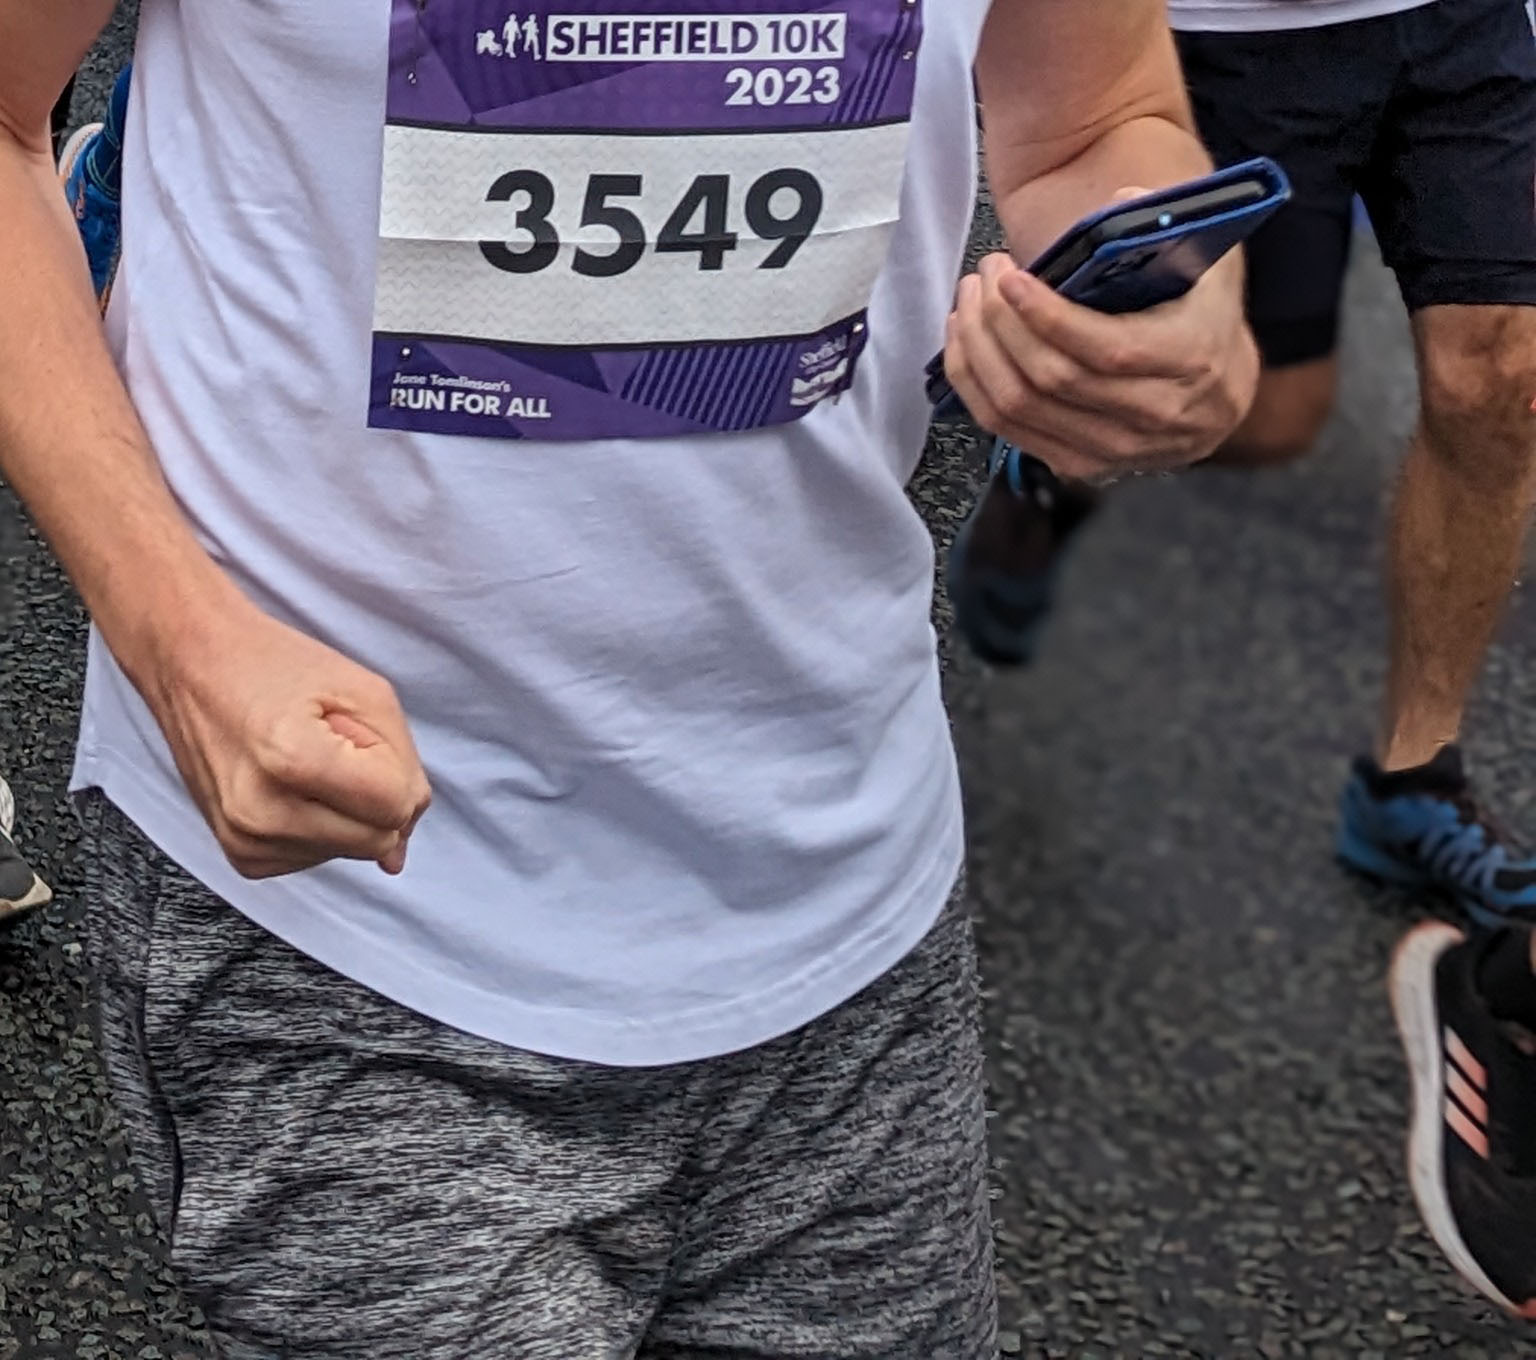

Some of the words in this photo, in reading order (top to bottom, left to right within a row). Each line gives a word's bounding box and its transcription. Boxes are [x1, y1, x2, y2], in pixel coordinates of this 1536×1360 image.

[551, 20, 758, 55] SHEFFIELD
[767, 19, 840, 53] 10K
[724, 66, 841, 106] 2023
[478, 167, 824, 278] 3549
[390, 388, 446, 411] RUN
[450, 391, 501, 416] FOR
[506, 397, 552, 418] ALL
